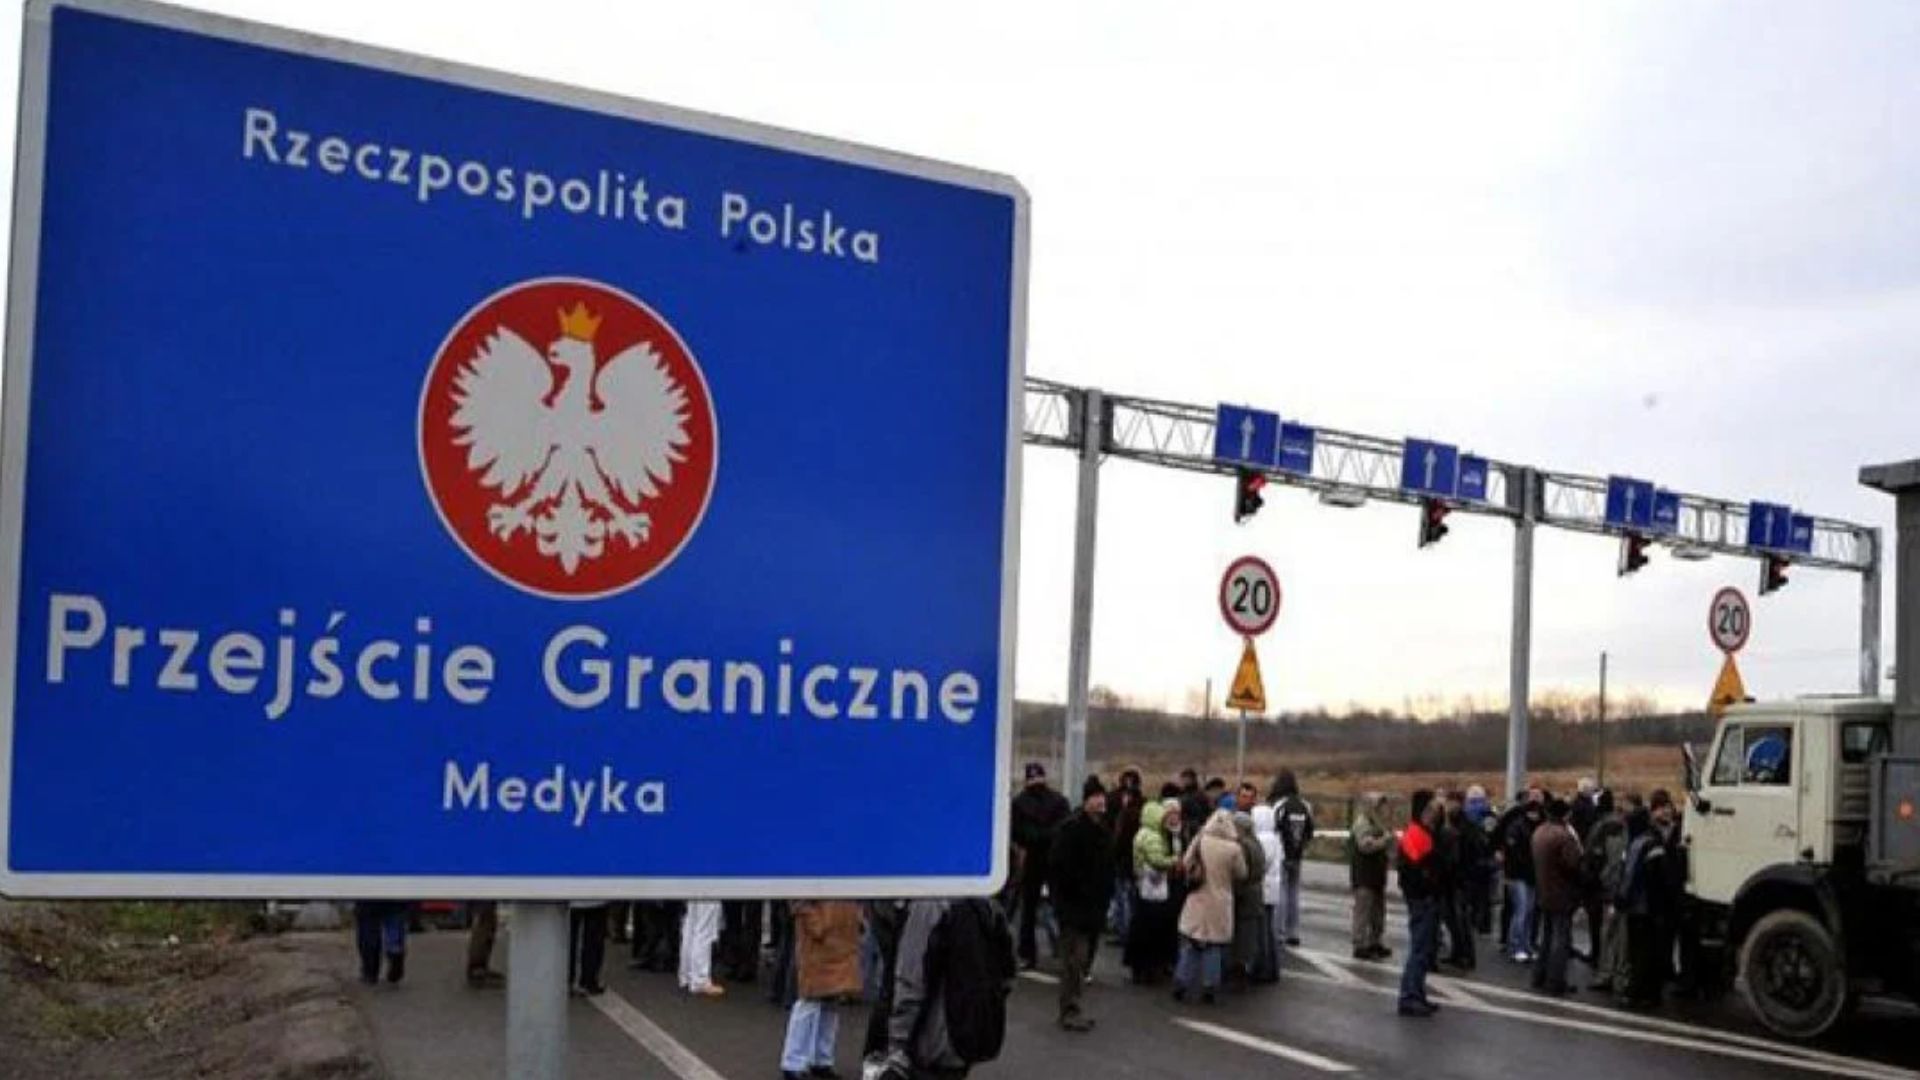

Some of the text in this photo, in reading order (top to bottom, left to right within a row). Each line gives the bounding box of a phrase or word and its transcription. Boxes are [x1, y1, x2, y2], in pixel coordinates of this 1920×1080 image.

[244, 108, 879, 262] Rzeczpospolita Polska
[1232, 576, 1272, 616] 20
[1718, 603, 1745, 636] 20
[47, 594, 981, 723] Przejście Graniczne
[443, 762, 666, 828] Medyka
